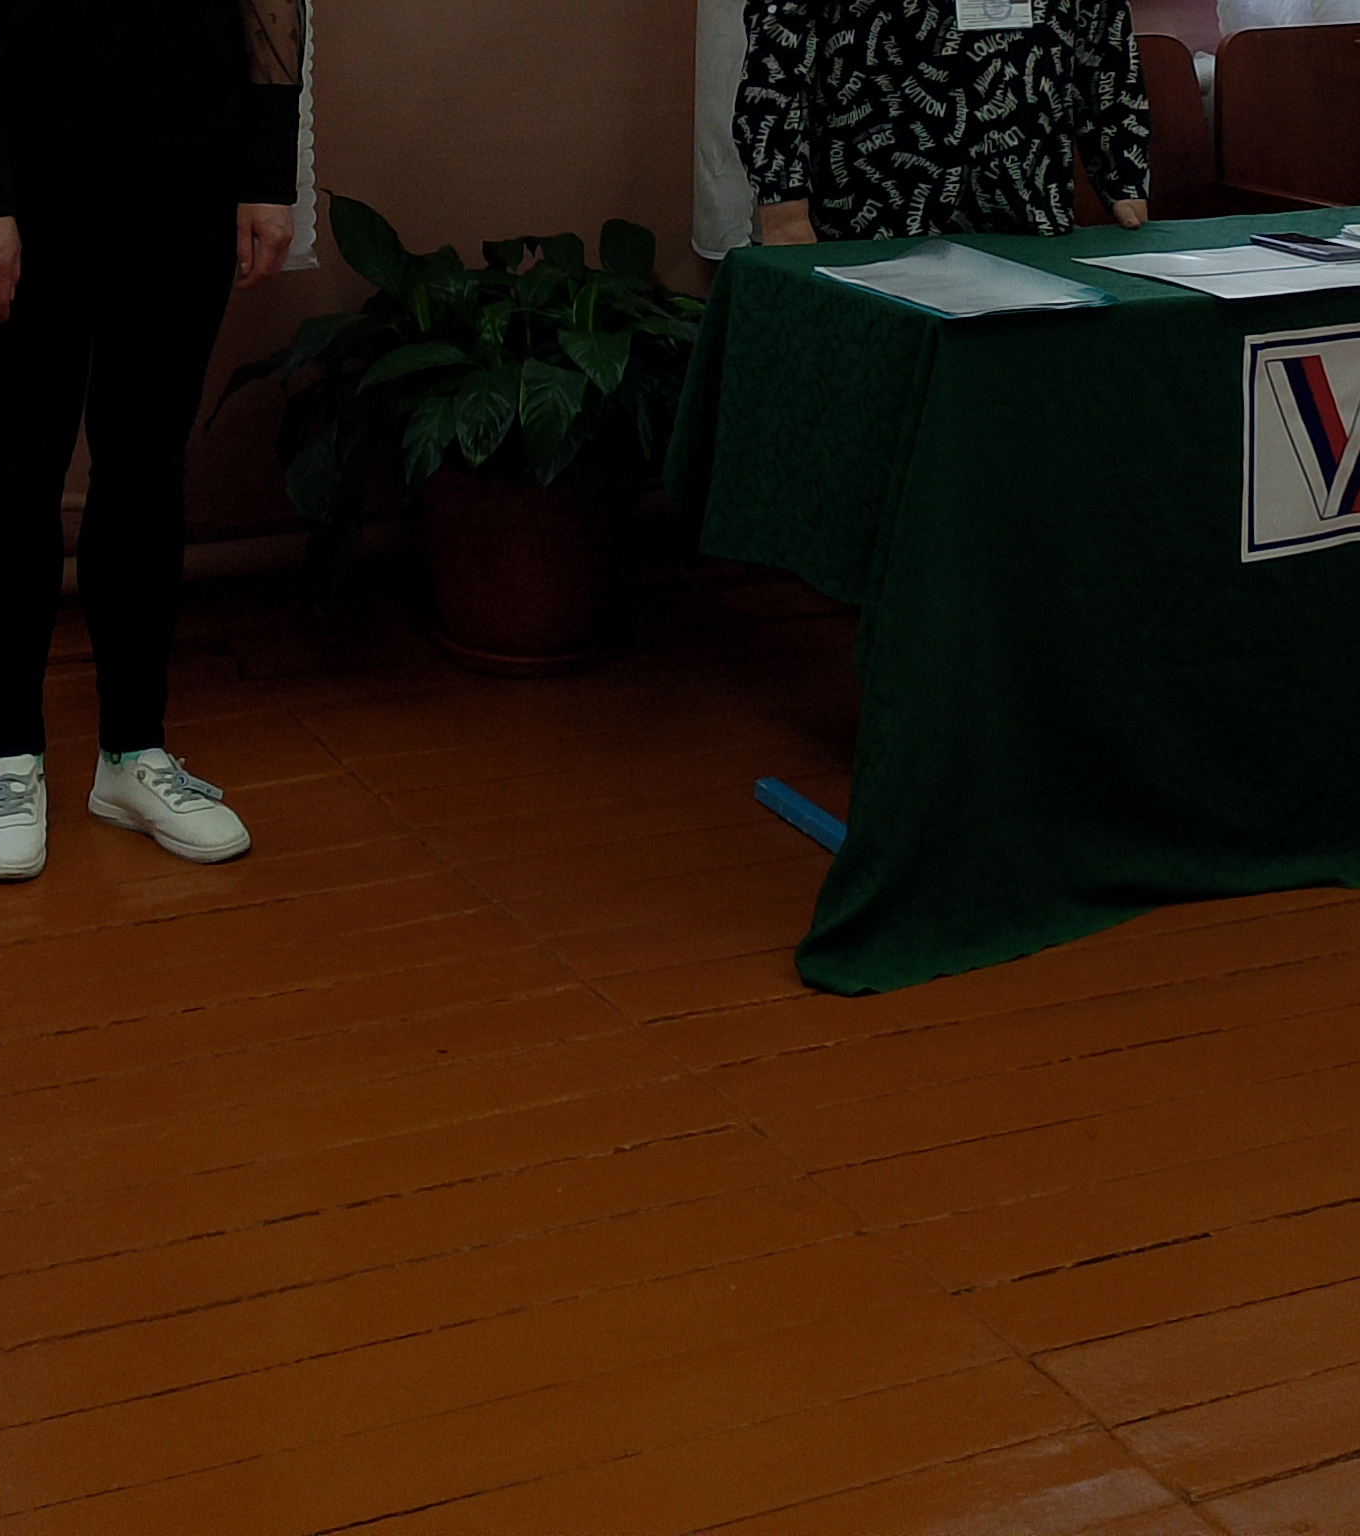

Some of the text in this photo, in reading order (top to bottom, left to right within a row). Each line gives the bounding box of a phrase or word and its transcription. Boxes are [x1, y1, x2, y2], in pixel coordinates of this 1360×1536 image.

[965, 32, 1005, 63] LOUIS
[836, 70, 867, 106] LOUIS
[900, 75, 947, 118] VUITTON
[1098, 70, 1116, 112] PARIS
[856, 129, 896, 156] PARIS
[909, 120, 937, 152] Rome
[939, 166, 962, 205] PARIS
[850, 198, 884, 234] LOUIS
[906, 182, 933, 236] VUITTON
